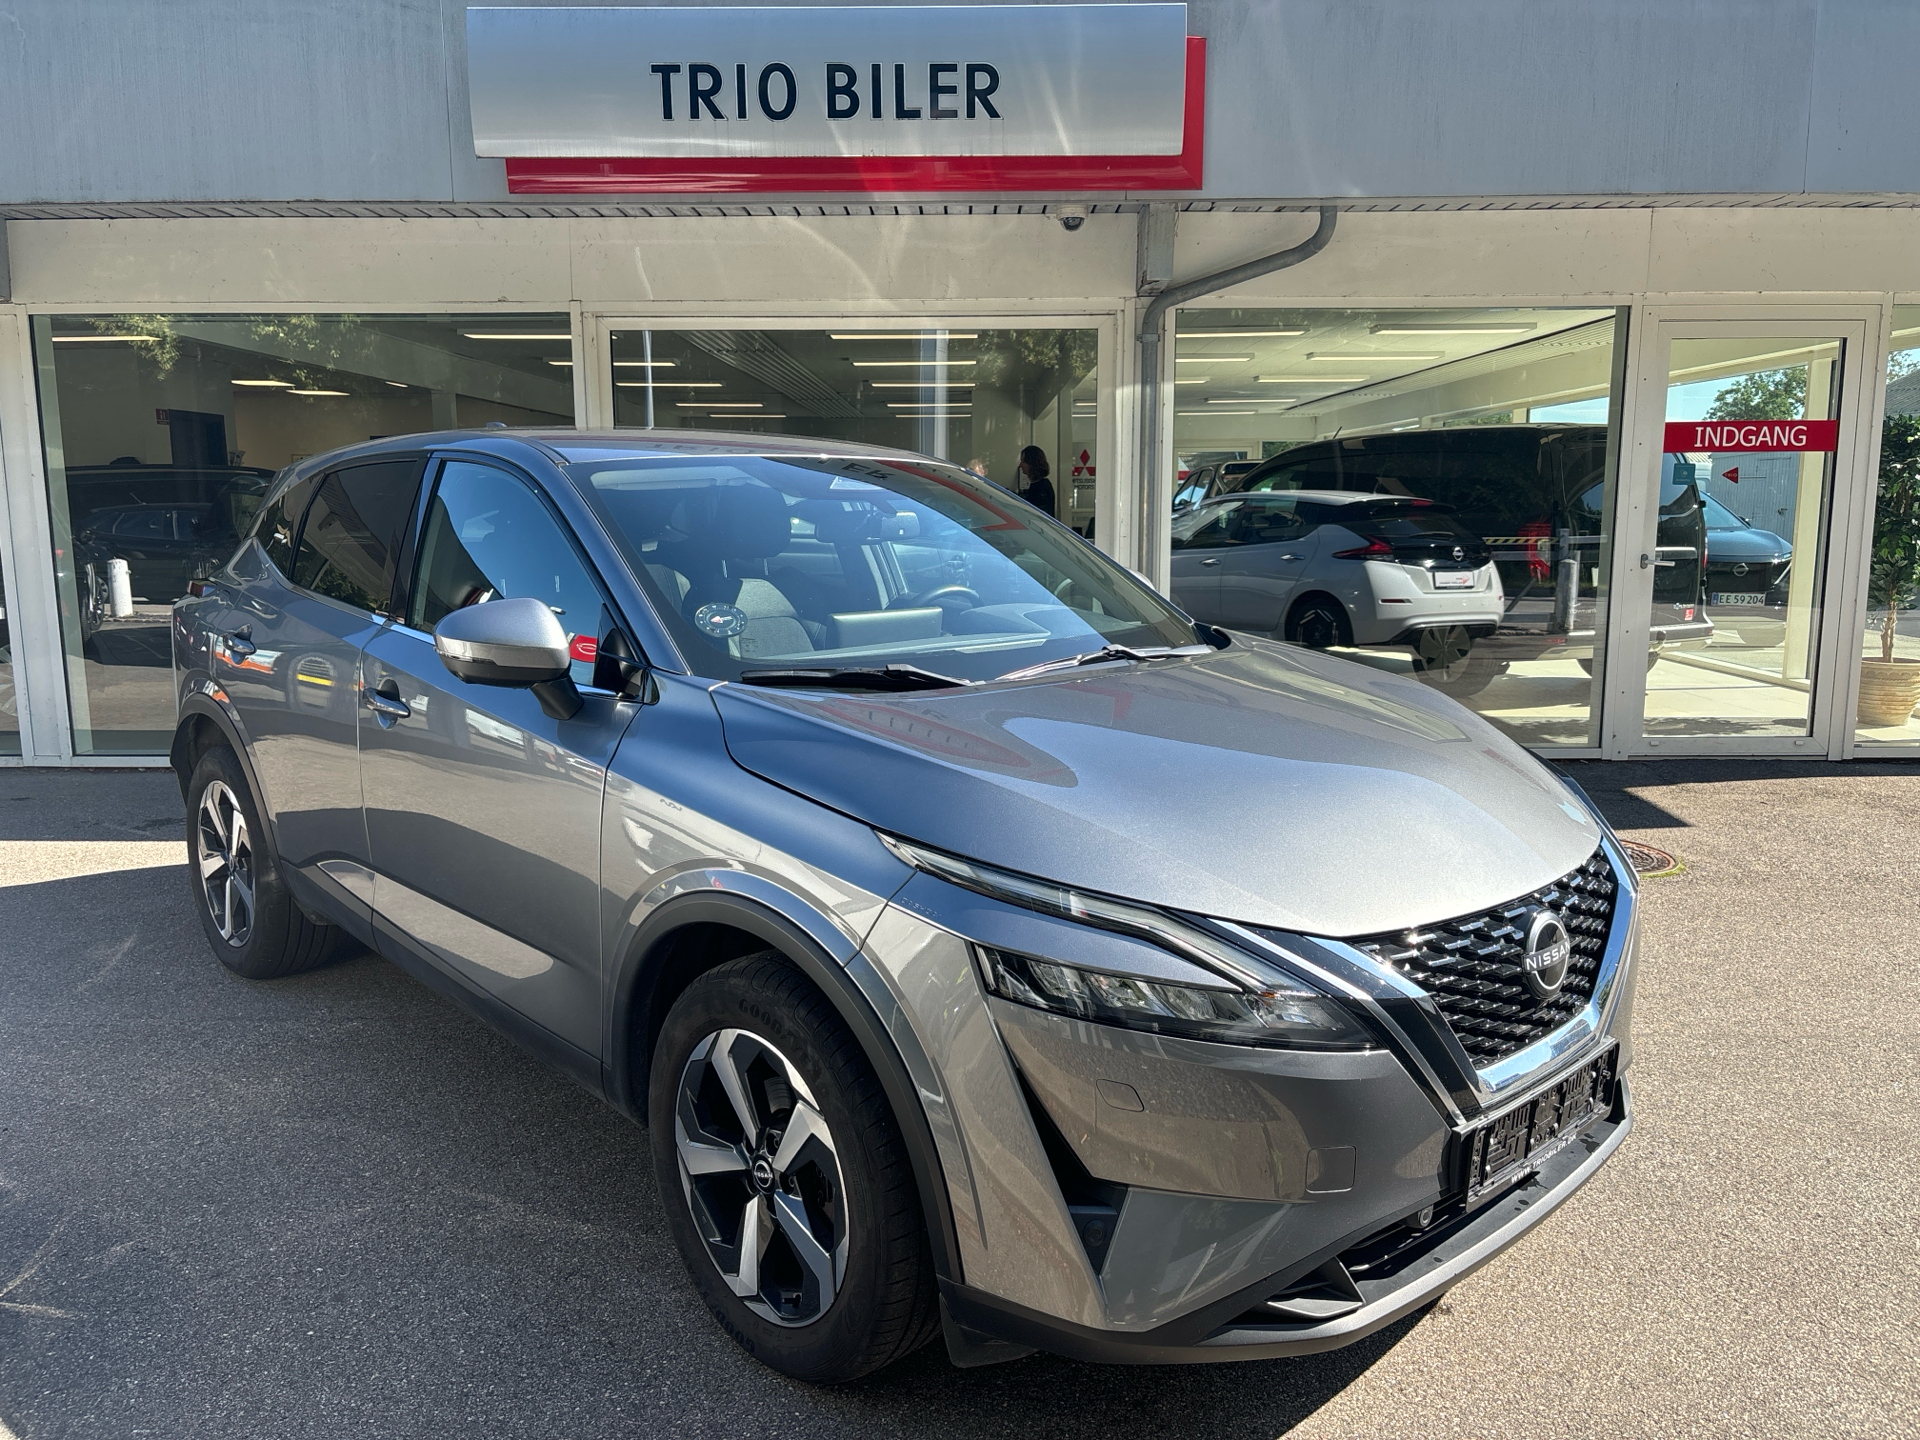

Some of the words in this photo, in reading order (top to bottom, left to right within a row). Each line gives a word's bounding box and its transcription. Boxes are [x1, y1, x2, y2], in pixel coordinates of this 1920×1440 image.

[650, 62, 798, 122] TRIO
[825, 62, 1003, 121] BILER
[1694, 425, 1808, 448] INDGANG
[1719, 595, 1731, 604] EE
[1734, 595, 1746, 604] 59
[1747, 595, 1764, 605] 204
[1525, 941, 1571, 970] NISSAN
